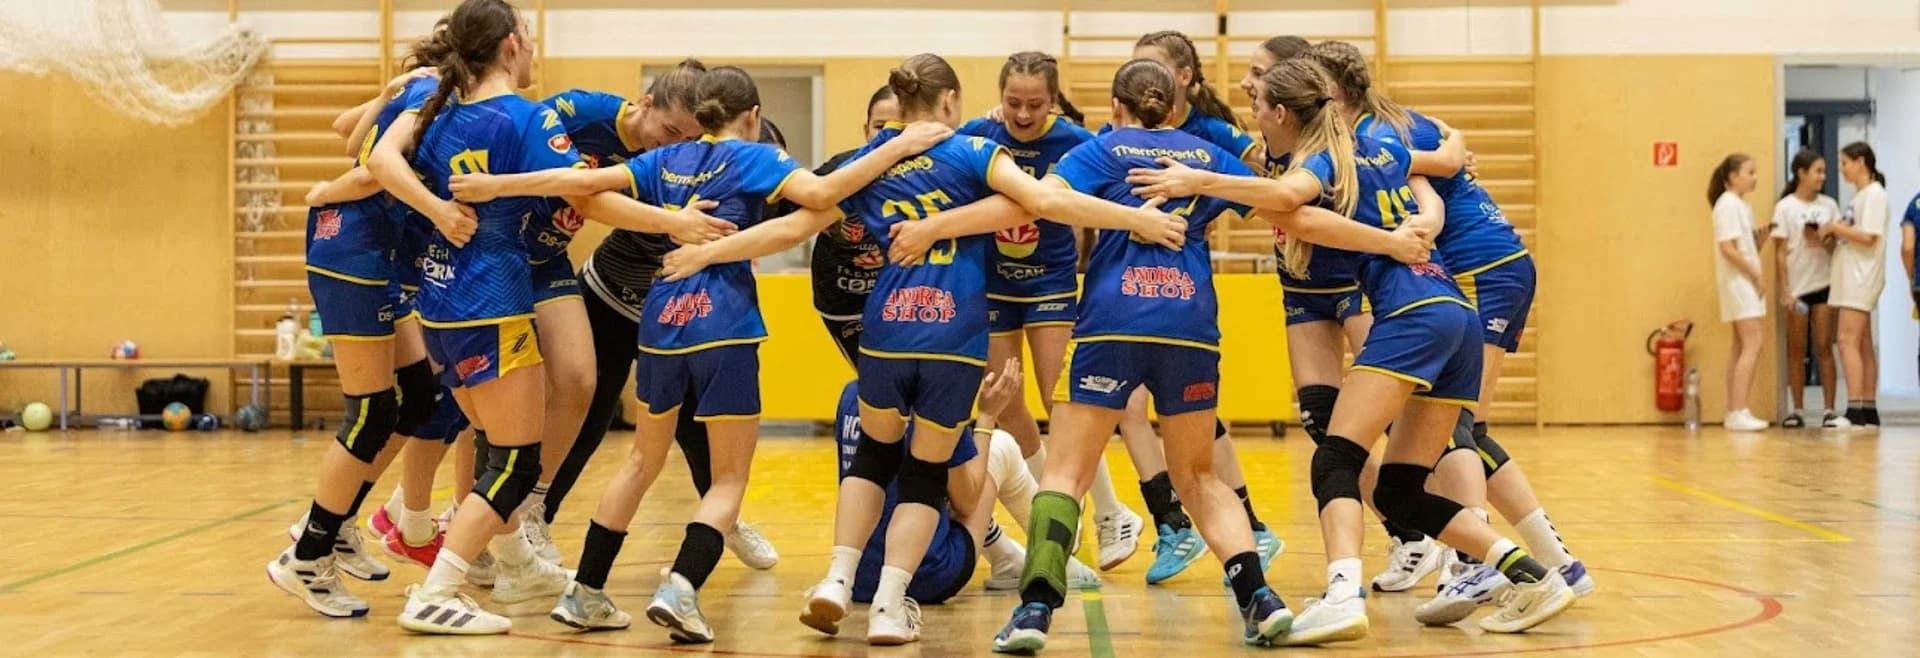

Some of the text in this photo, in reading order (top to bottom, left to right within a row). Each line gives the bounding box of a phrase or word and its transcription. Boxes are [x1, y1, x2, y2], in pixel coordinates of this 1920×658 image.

[1121, 266, 1195, 286] ANDREA
[884, 285, 956, 308] ANDREA
[1121, 281, 1196, 300] SHOP
[882, 306, 957, 323] SHOP
